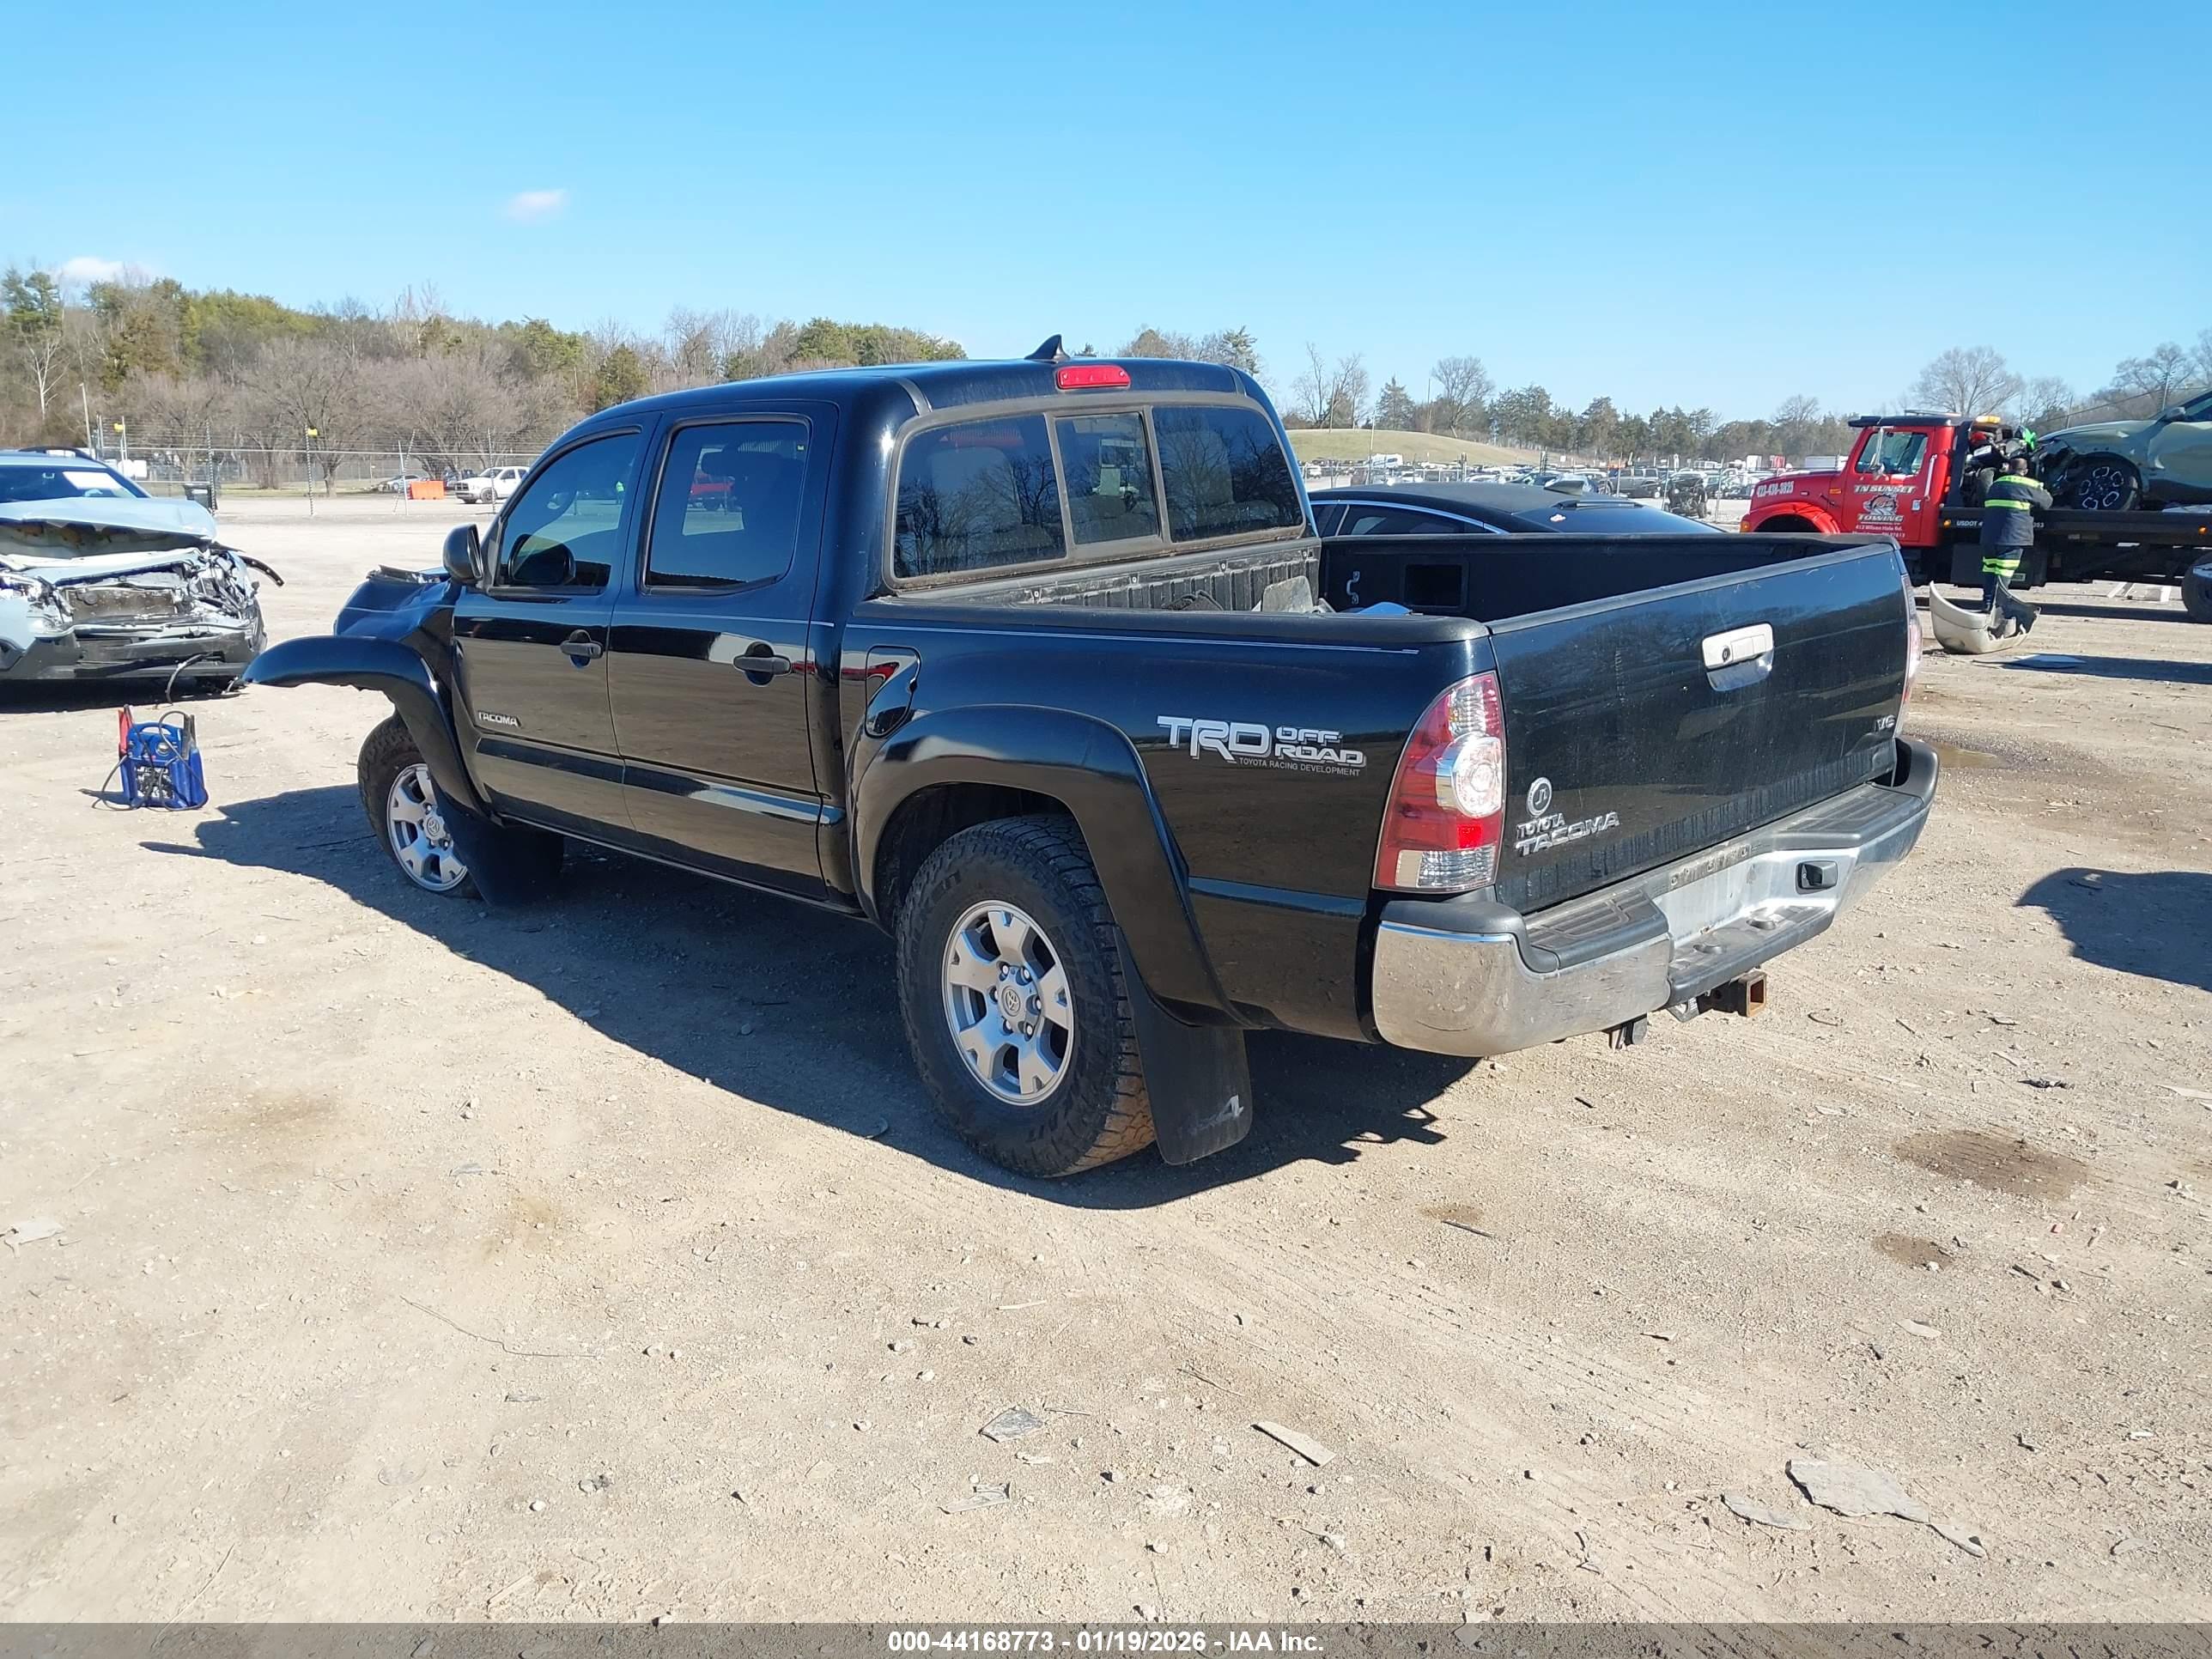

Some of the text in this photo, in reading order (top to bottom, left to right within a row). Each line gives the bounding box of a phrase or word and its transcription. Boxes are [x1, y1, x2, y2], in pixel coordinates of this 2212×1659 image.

[1870, 485, 1915, 494] SUNSET
[478, 712, 519, 727] TACOMA
[1876, 714, 1895, 729] V6
[1157, 714, 1273, 763] TRD
[1275, 725, 1342, 746] OFF
[1274, 743, 1367, 768] ROAD
[1238, 757, 1360, 776] TOYOTA RACING DEVELOPMENT
[1515, 811, 1621, 856] TACOMA
[1516, 812, 1565, 839] TOYOTA
